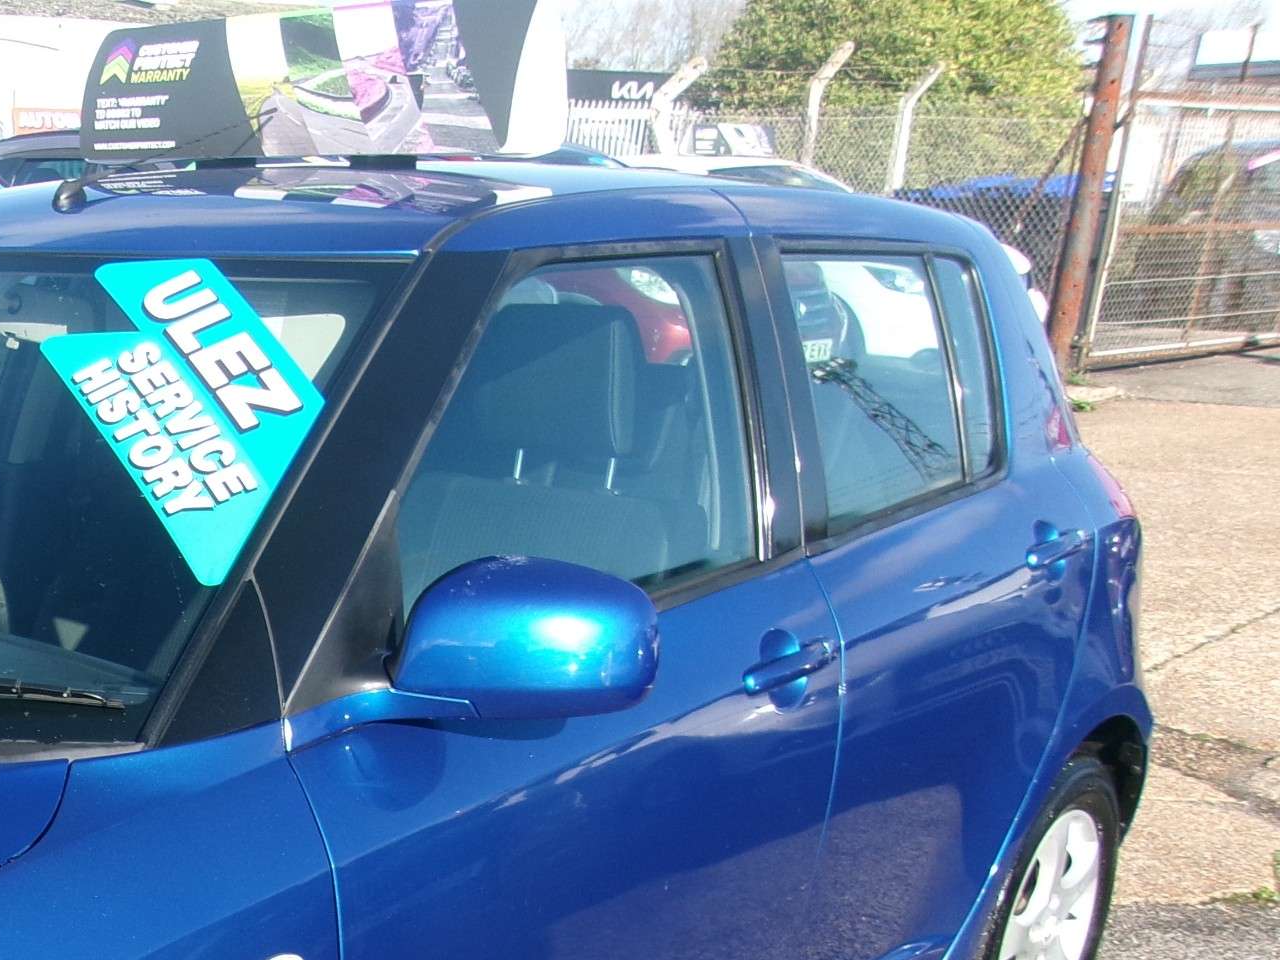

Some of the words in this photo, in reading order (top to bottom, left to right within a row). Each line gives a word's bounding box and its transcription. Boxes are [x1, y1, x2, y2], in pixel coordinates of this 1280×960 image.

[130, 68, 191, 84] WARRANTY
[612, 80, 654, 99] KIA
[117, 340, 259, 506] SERVICE
[141, 269, 304, 435] ULEZ
[71, 357, 216, 517] HISTORY
